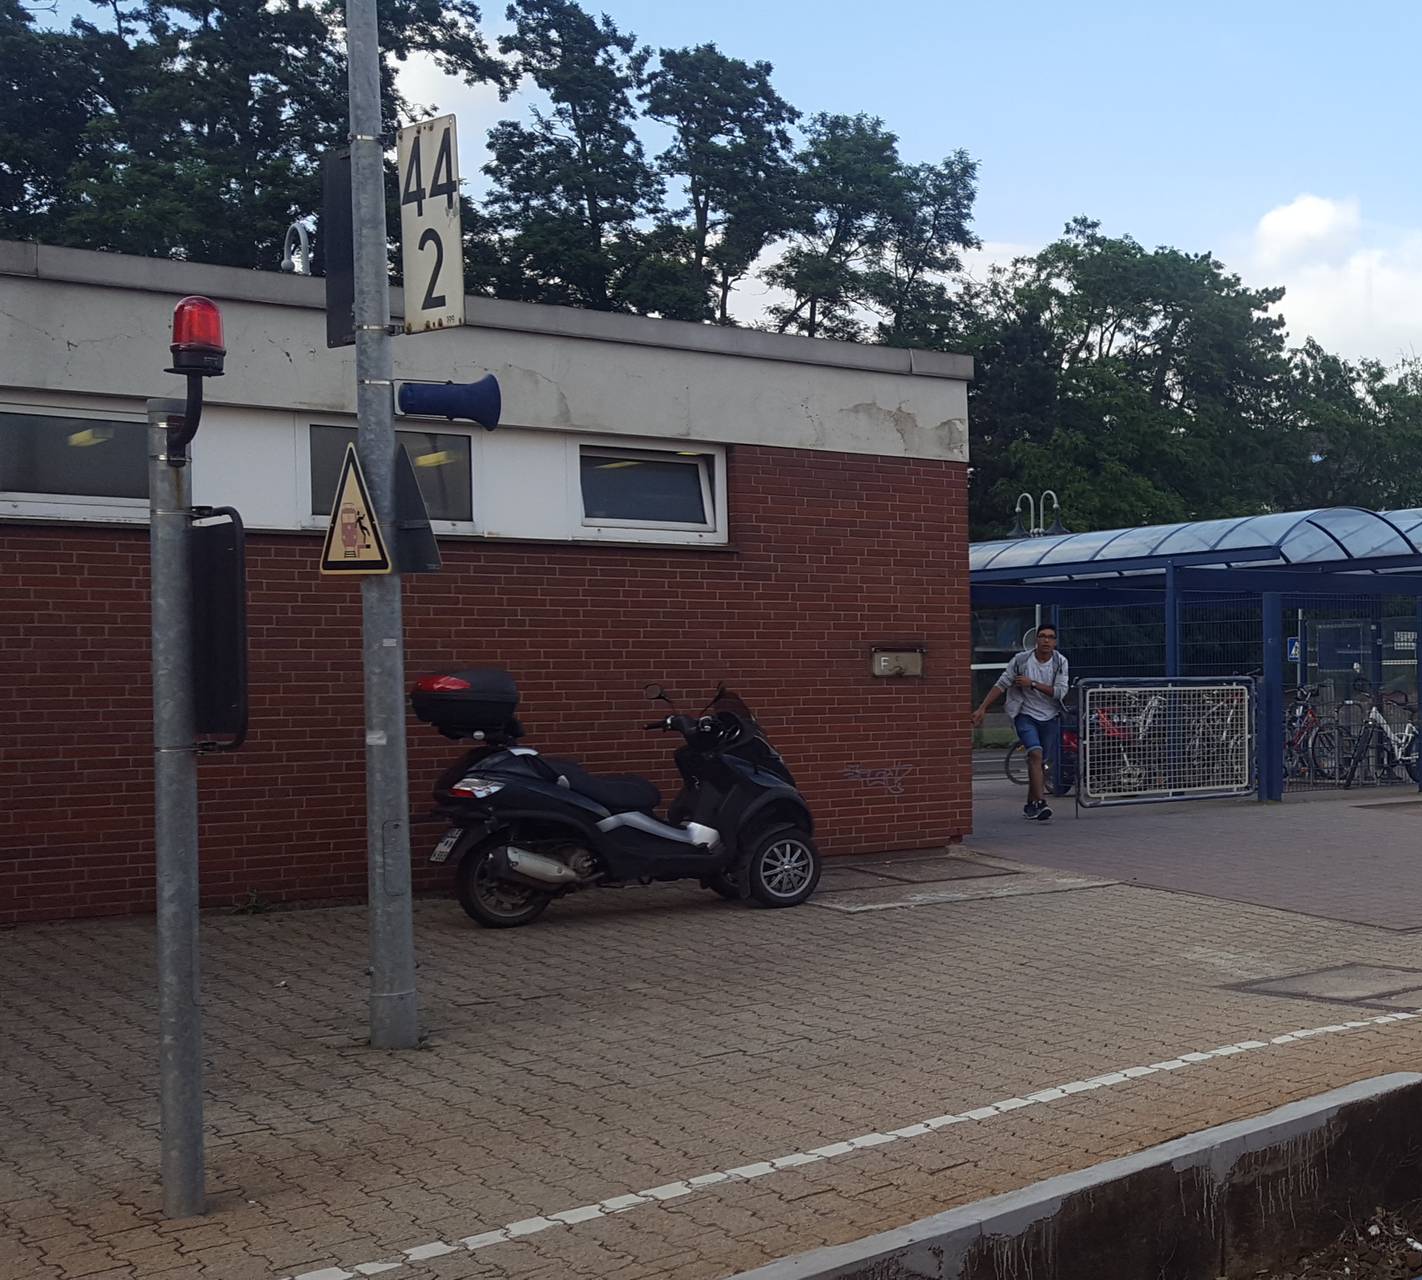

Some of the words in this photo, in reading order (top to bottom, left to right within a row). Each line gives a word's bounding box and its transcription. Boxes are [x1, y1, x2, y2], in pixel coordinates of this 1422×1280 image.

[402, 127, 457, 217] 44
[418, 228, 447, 310] 2
[880, 656, 889, 670] F
